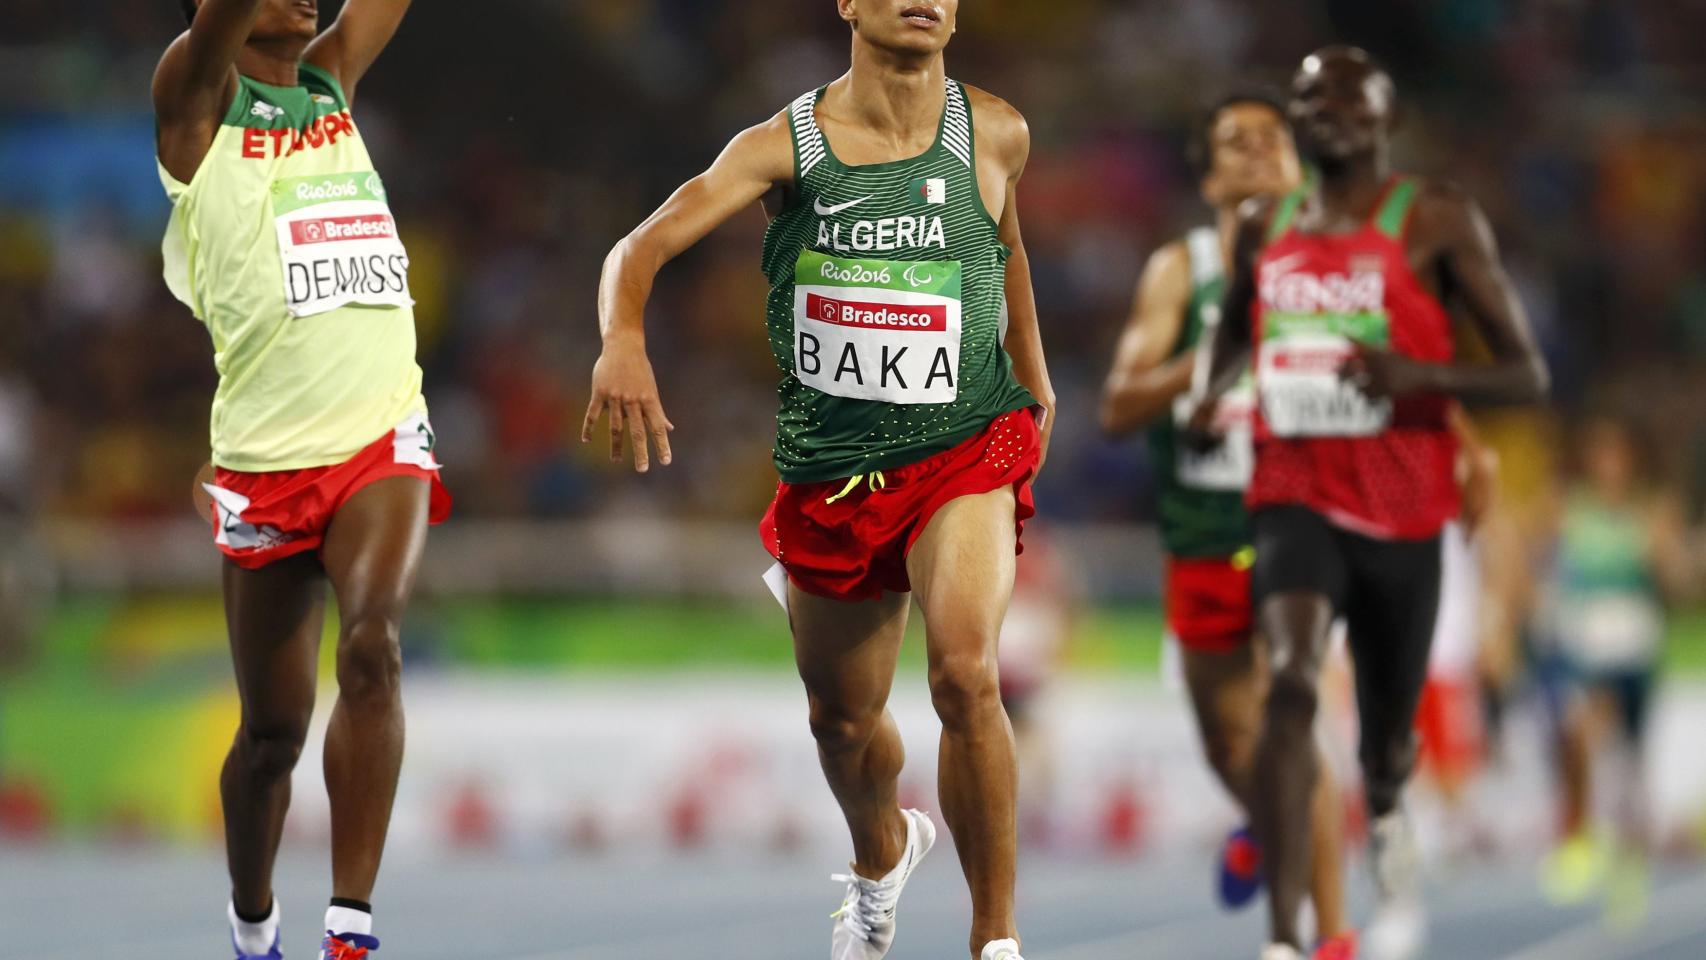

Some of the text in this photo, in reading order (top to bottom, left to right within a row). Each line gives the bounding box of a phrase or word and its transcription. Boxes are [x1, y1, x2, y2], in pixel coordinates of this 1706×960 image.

[296, 179, 358, 200] Rio2016
[815, 216, 946, 251] ALGERIA
[821, 261, 891, 284] Rio2016
[842, 305, 932, 327] Bradesco
[799, 331, 954, 389] BAKA
